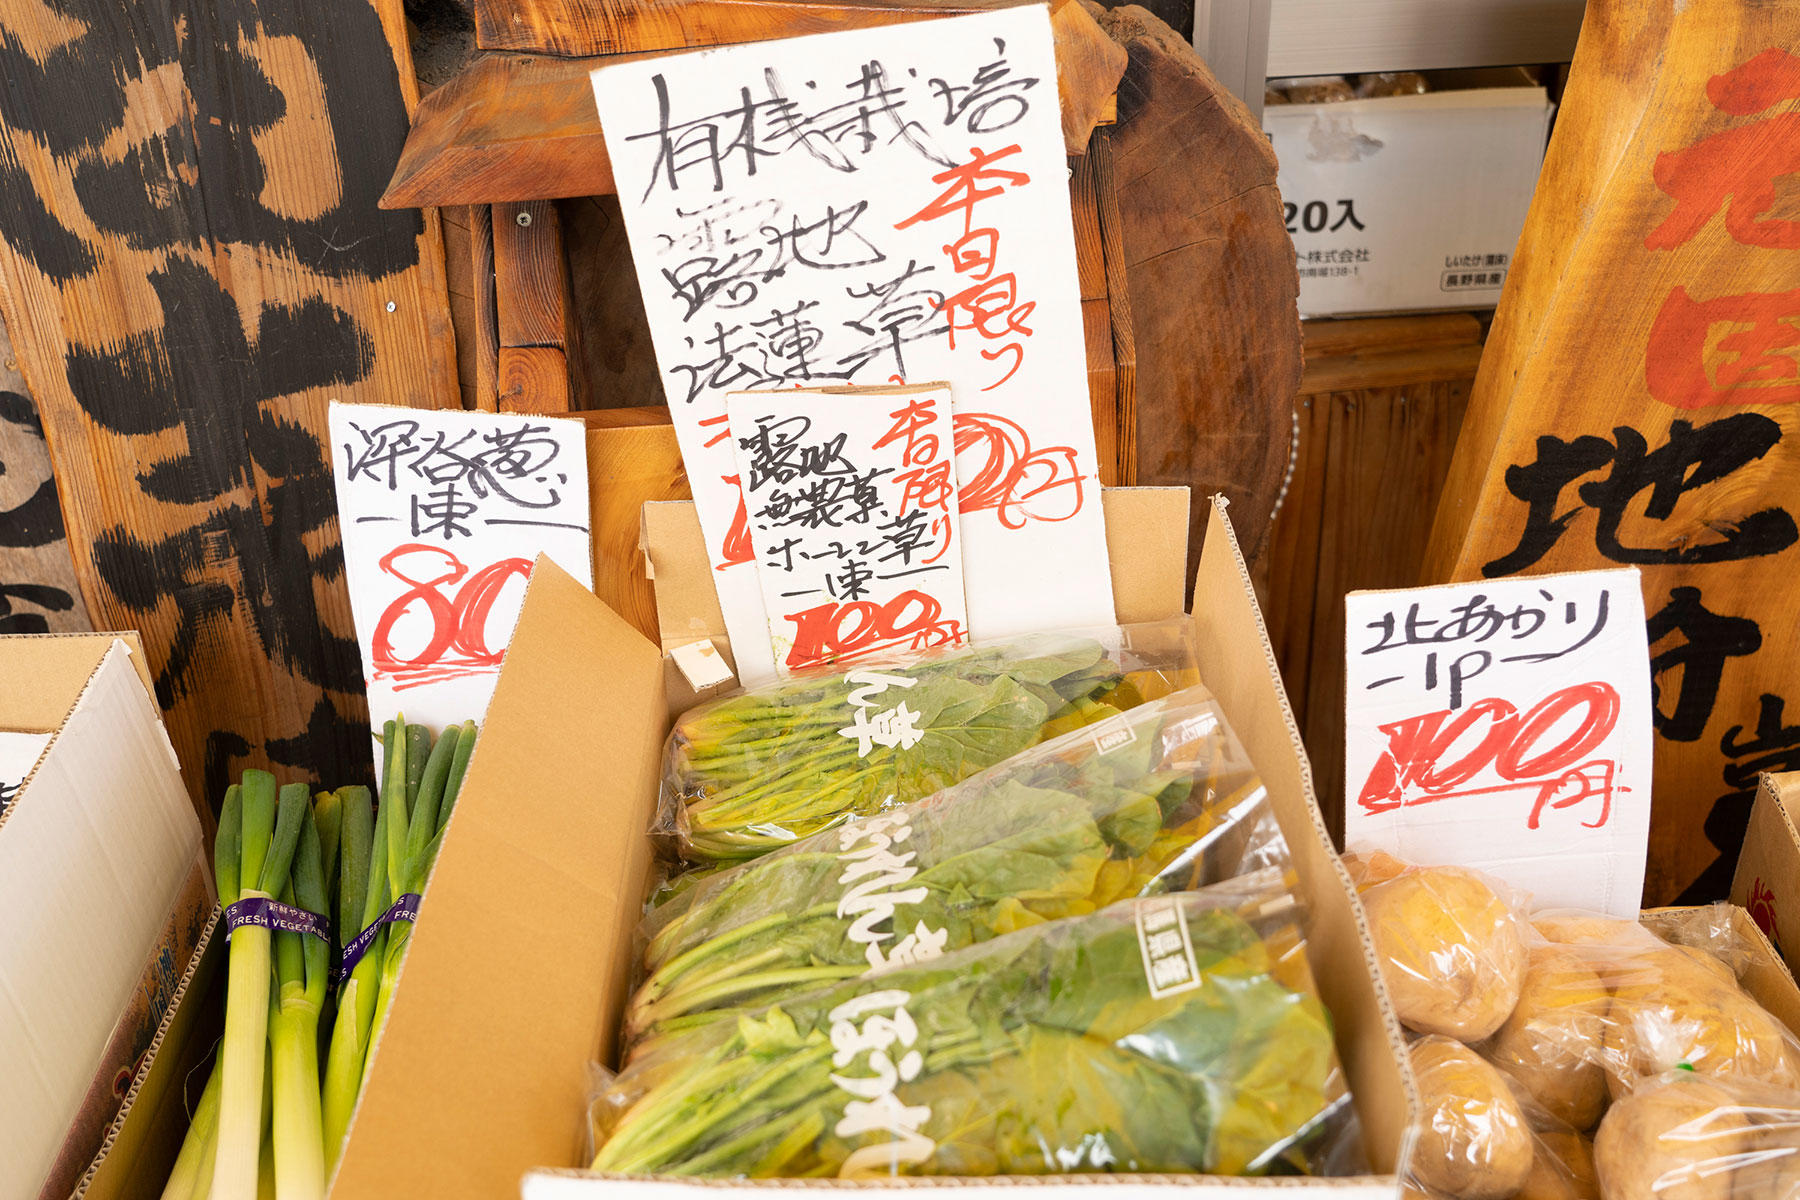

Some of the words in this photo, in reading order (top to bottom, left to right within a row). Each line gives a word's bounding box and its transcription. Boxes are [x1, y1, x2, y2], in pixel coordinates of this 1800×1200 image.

[1361, 589, 1610, 656] 北あかり
[232, 915, 269, 929] FRESH
